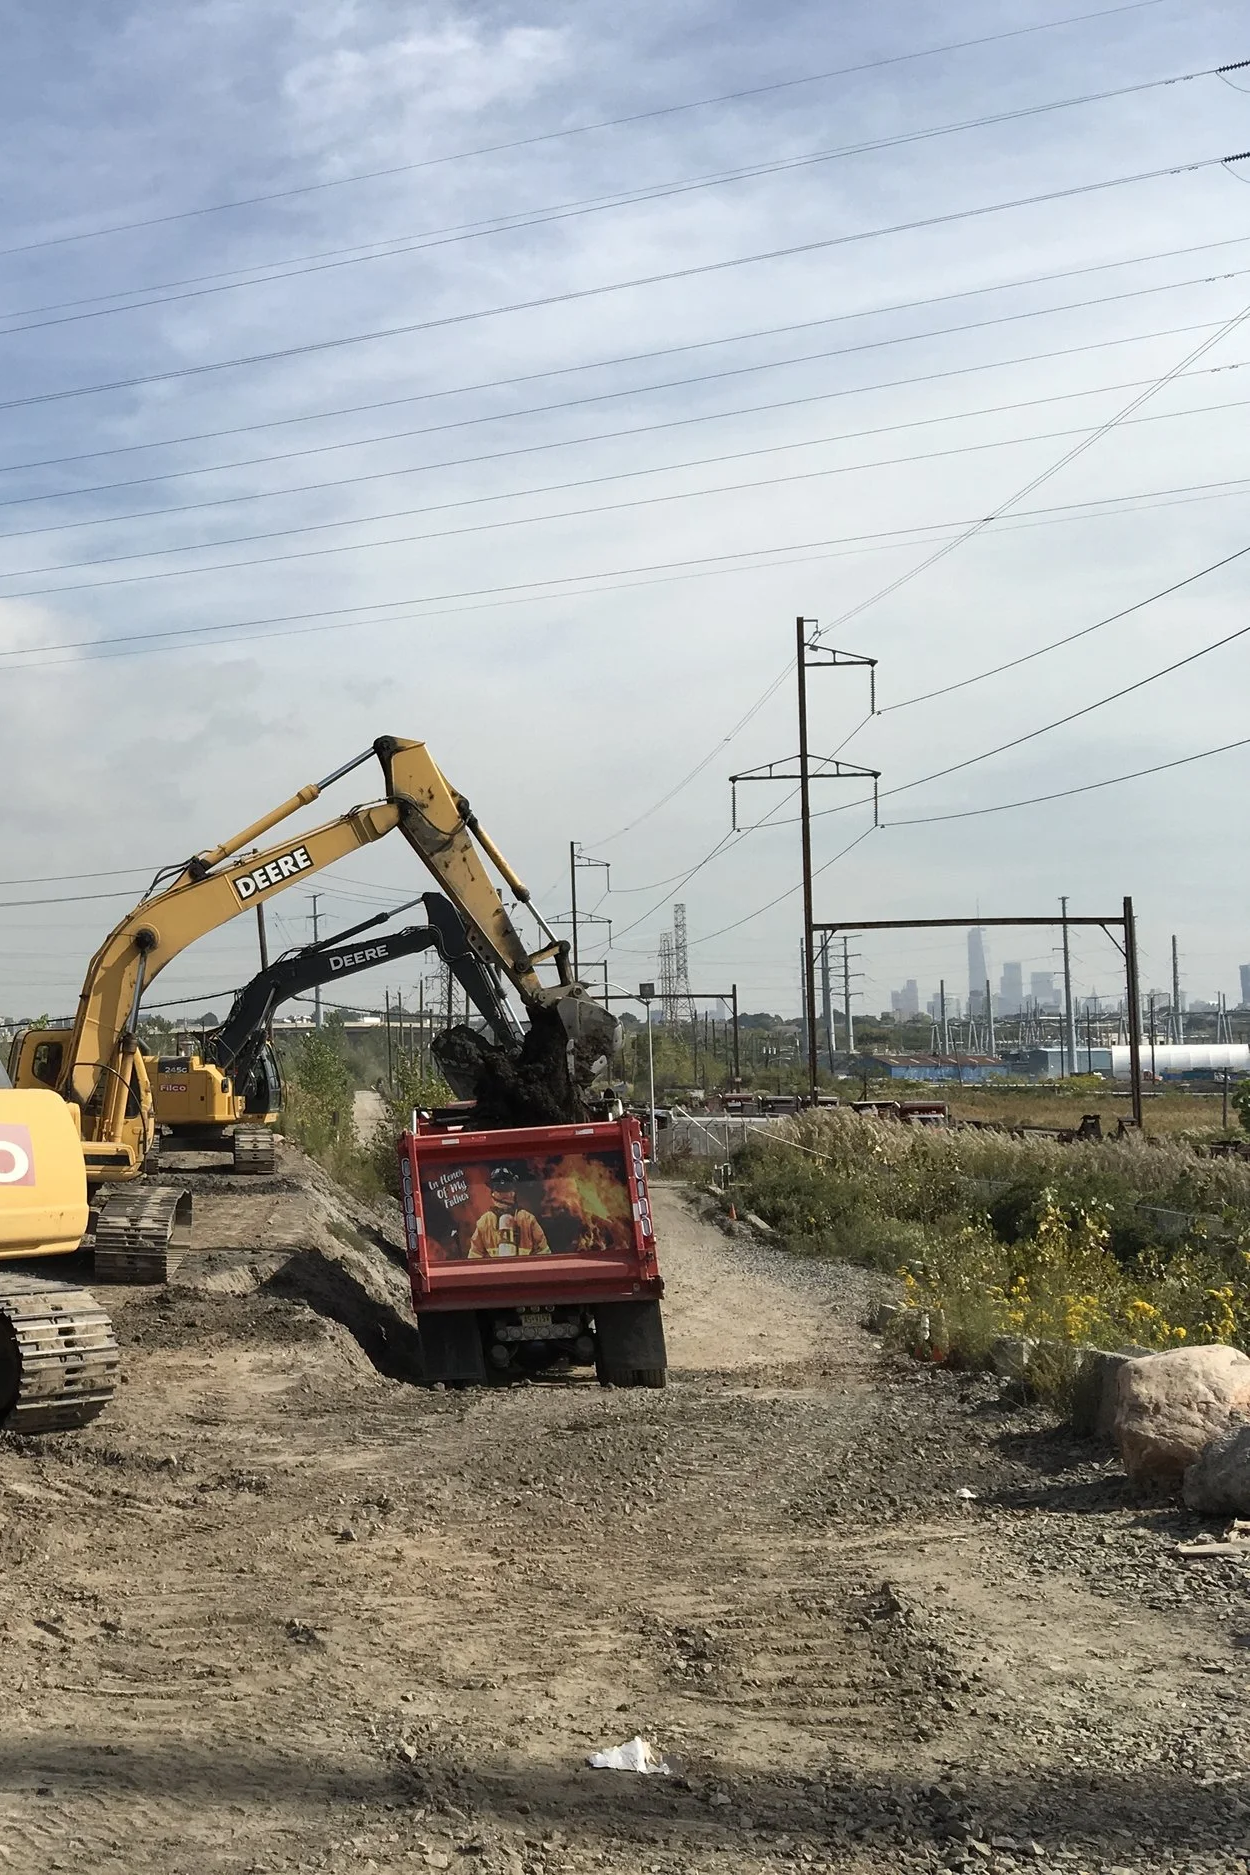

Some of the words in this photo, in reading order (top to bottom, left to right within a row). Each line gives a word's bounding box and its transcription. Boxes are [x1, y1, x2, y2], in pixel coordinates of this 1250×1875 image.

[234, 847, 313, 899] DEERE
[329, 944, 389, 971] DEERE
[160, 1084, 187, 1092] Filco
[428, 1181, 439, 1190] In
[440, 1169, 464, 1185] Honor
[450, 1180, 467, 1193] My
[444, 1192, 469, 1209] Father
